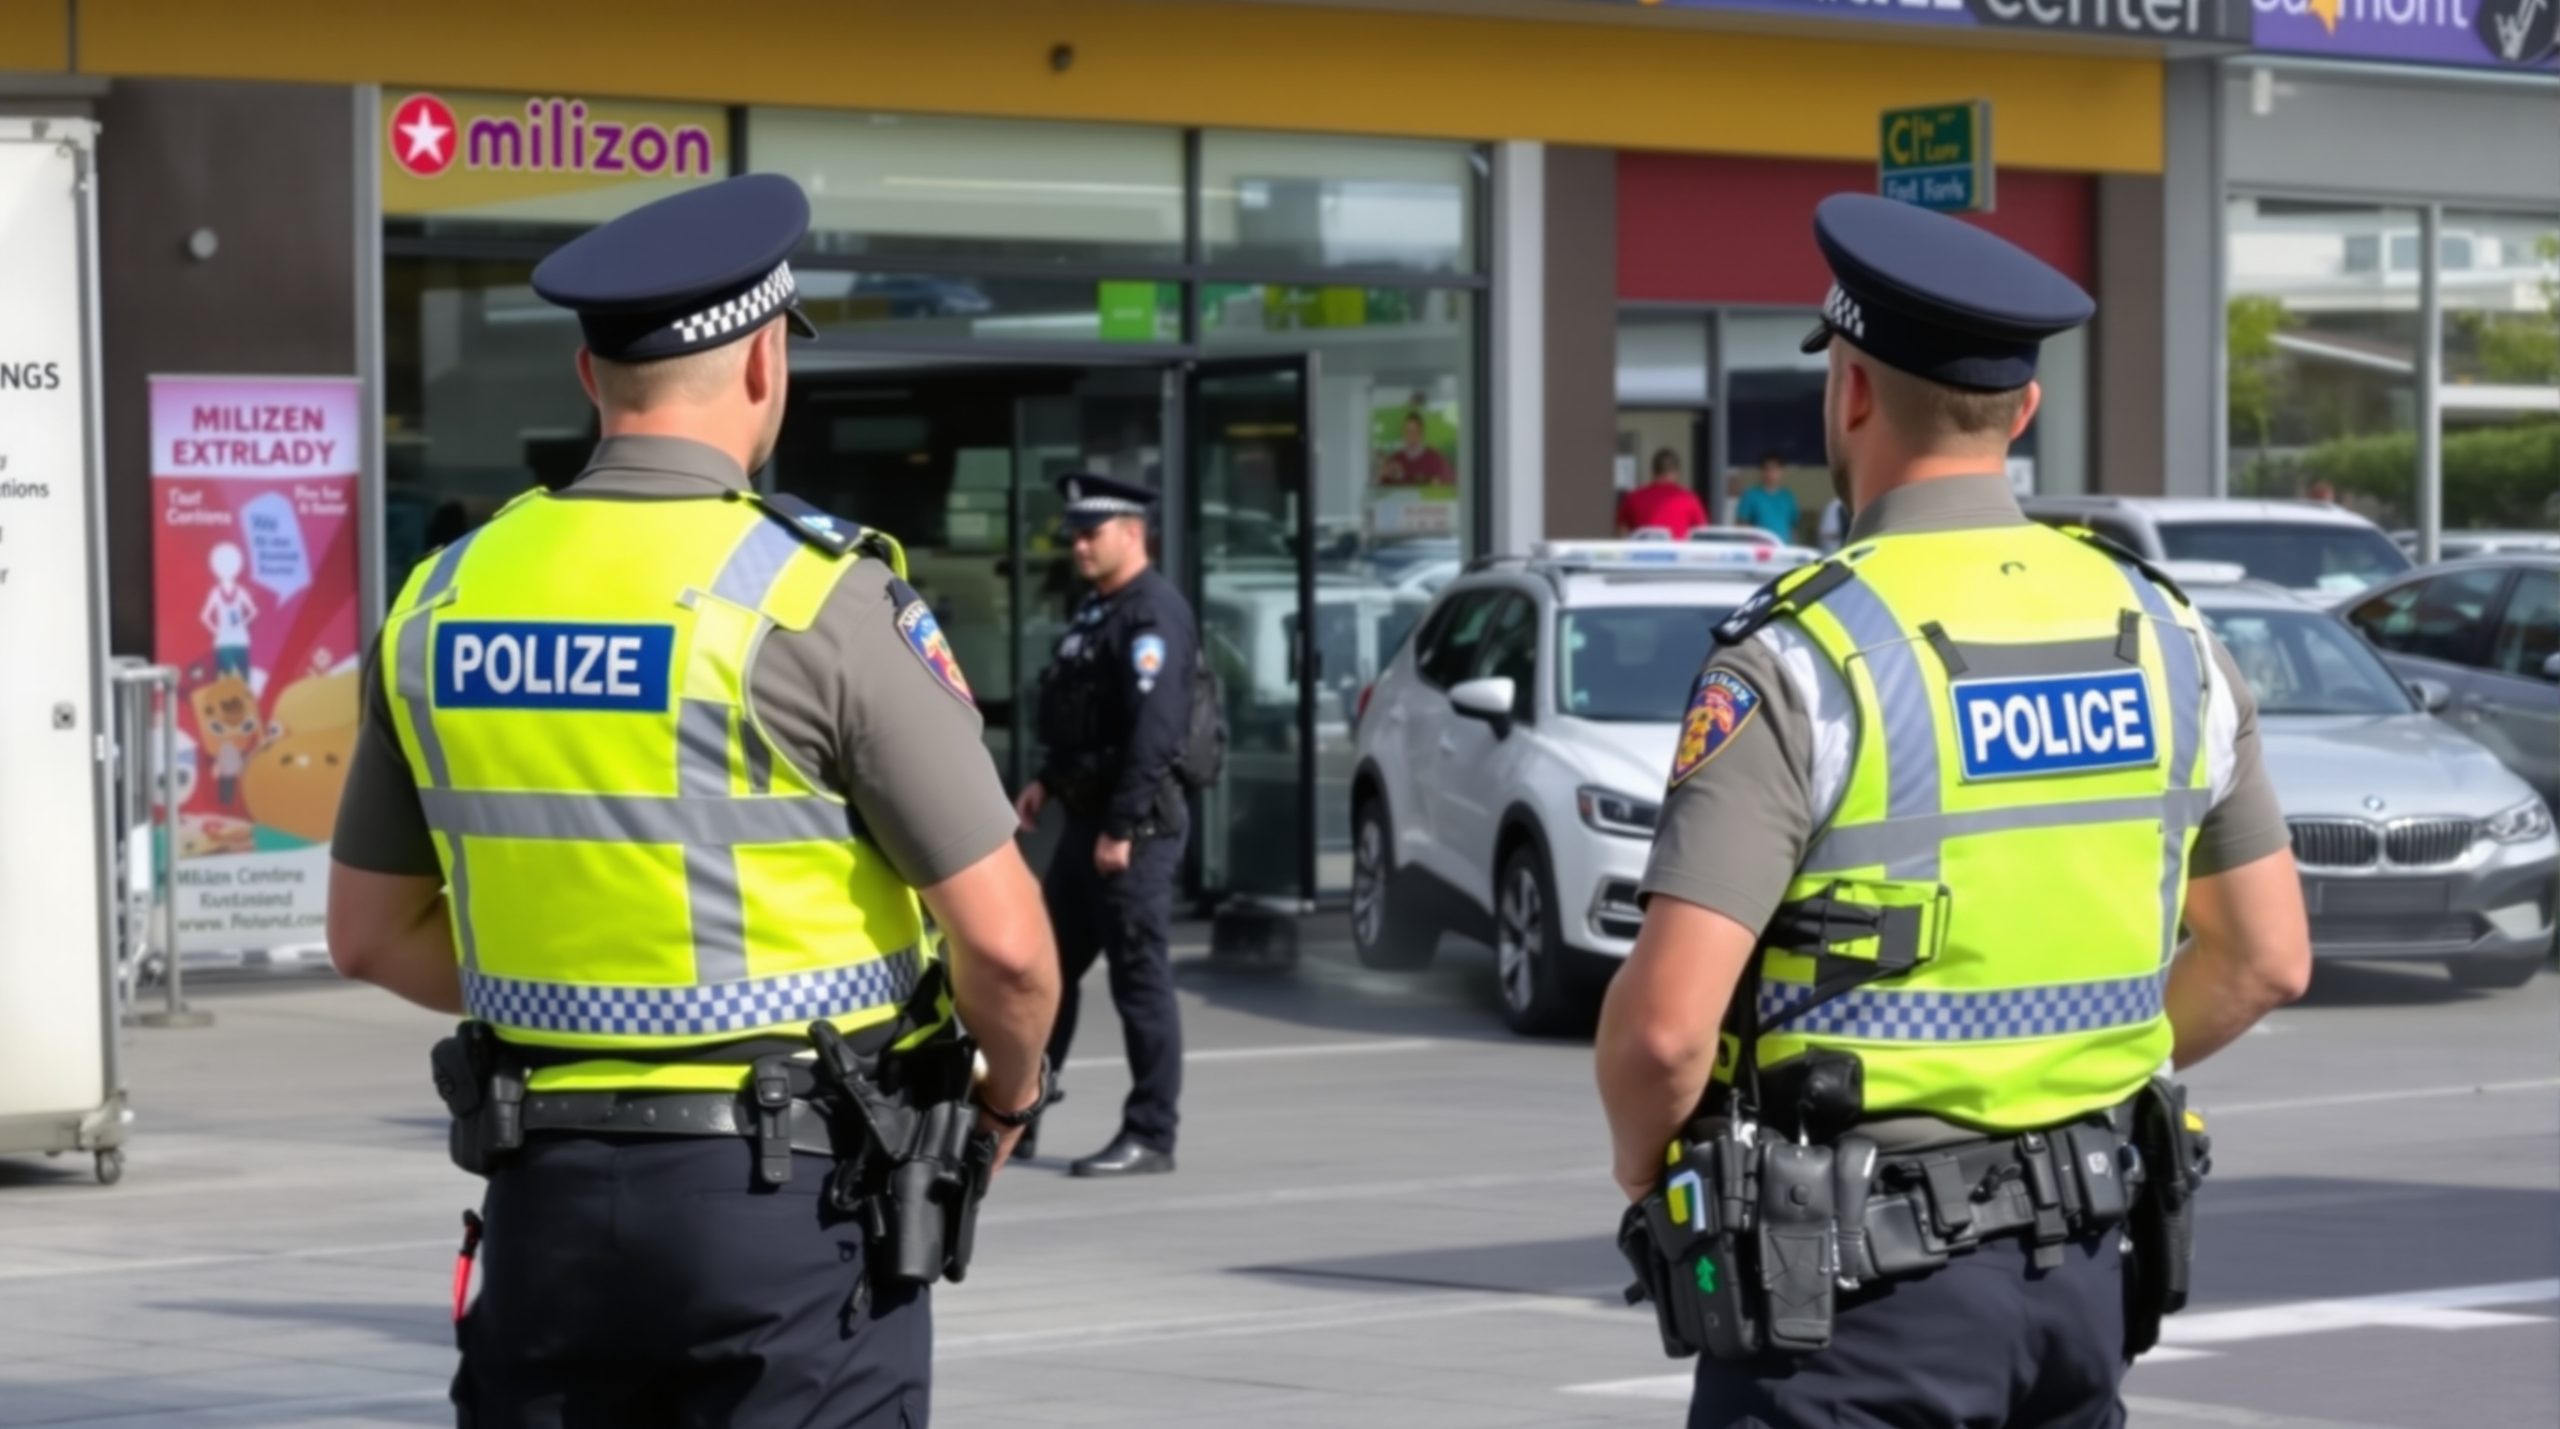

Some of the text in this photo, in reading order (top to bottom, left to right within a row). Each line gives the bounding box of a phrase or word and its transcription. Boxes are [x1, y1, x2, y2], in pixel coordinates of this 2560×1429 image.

[467, 102, 711, 174] milizon
[0, 362, 60, 390] NGS
[193, 405, 325, 433] MILIZEN
[173, 438, 335, 467] EXTRLADY
[453, 633, 642, 697] POLIZE
[1968, 688, 2146, 763] POLICE
